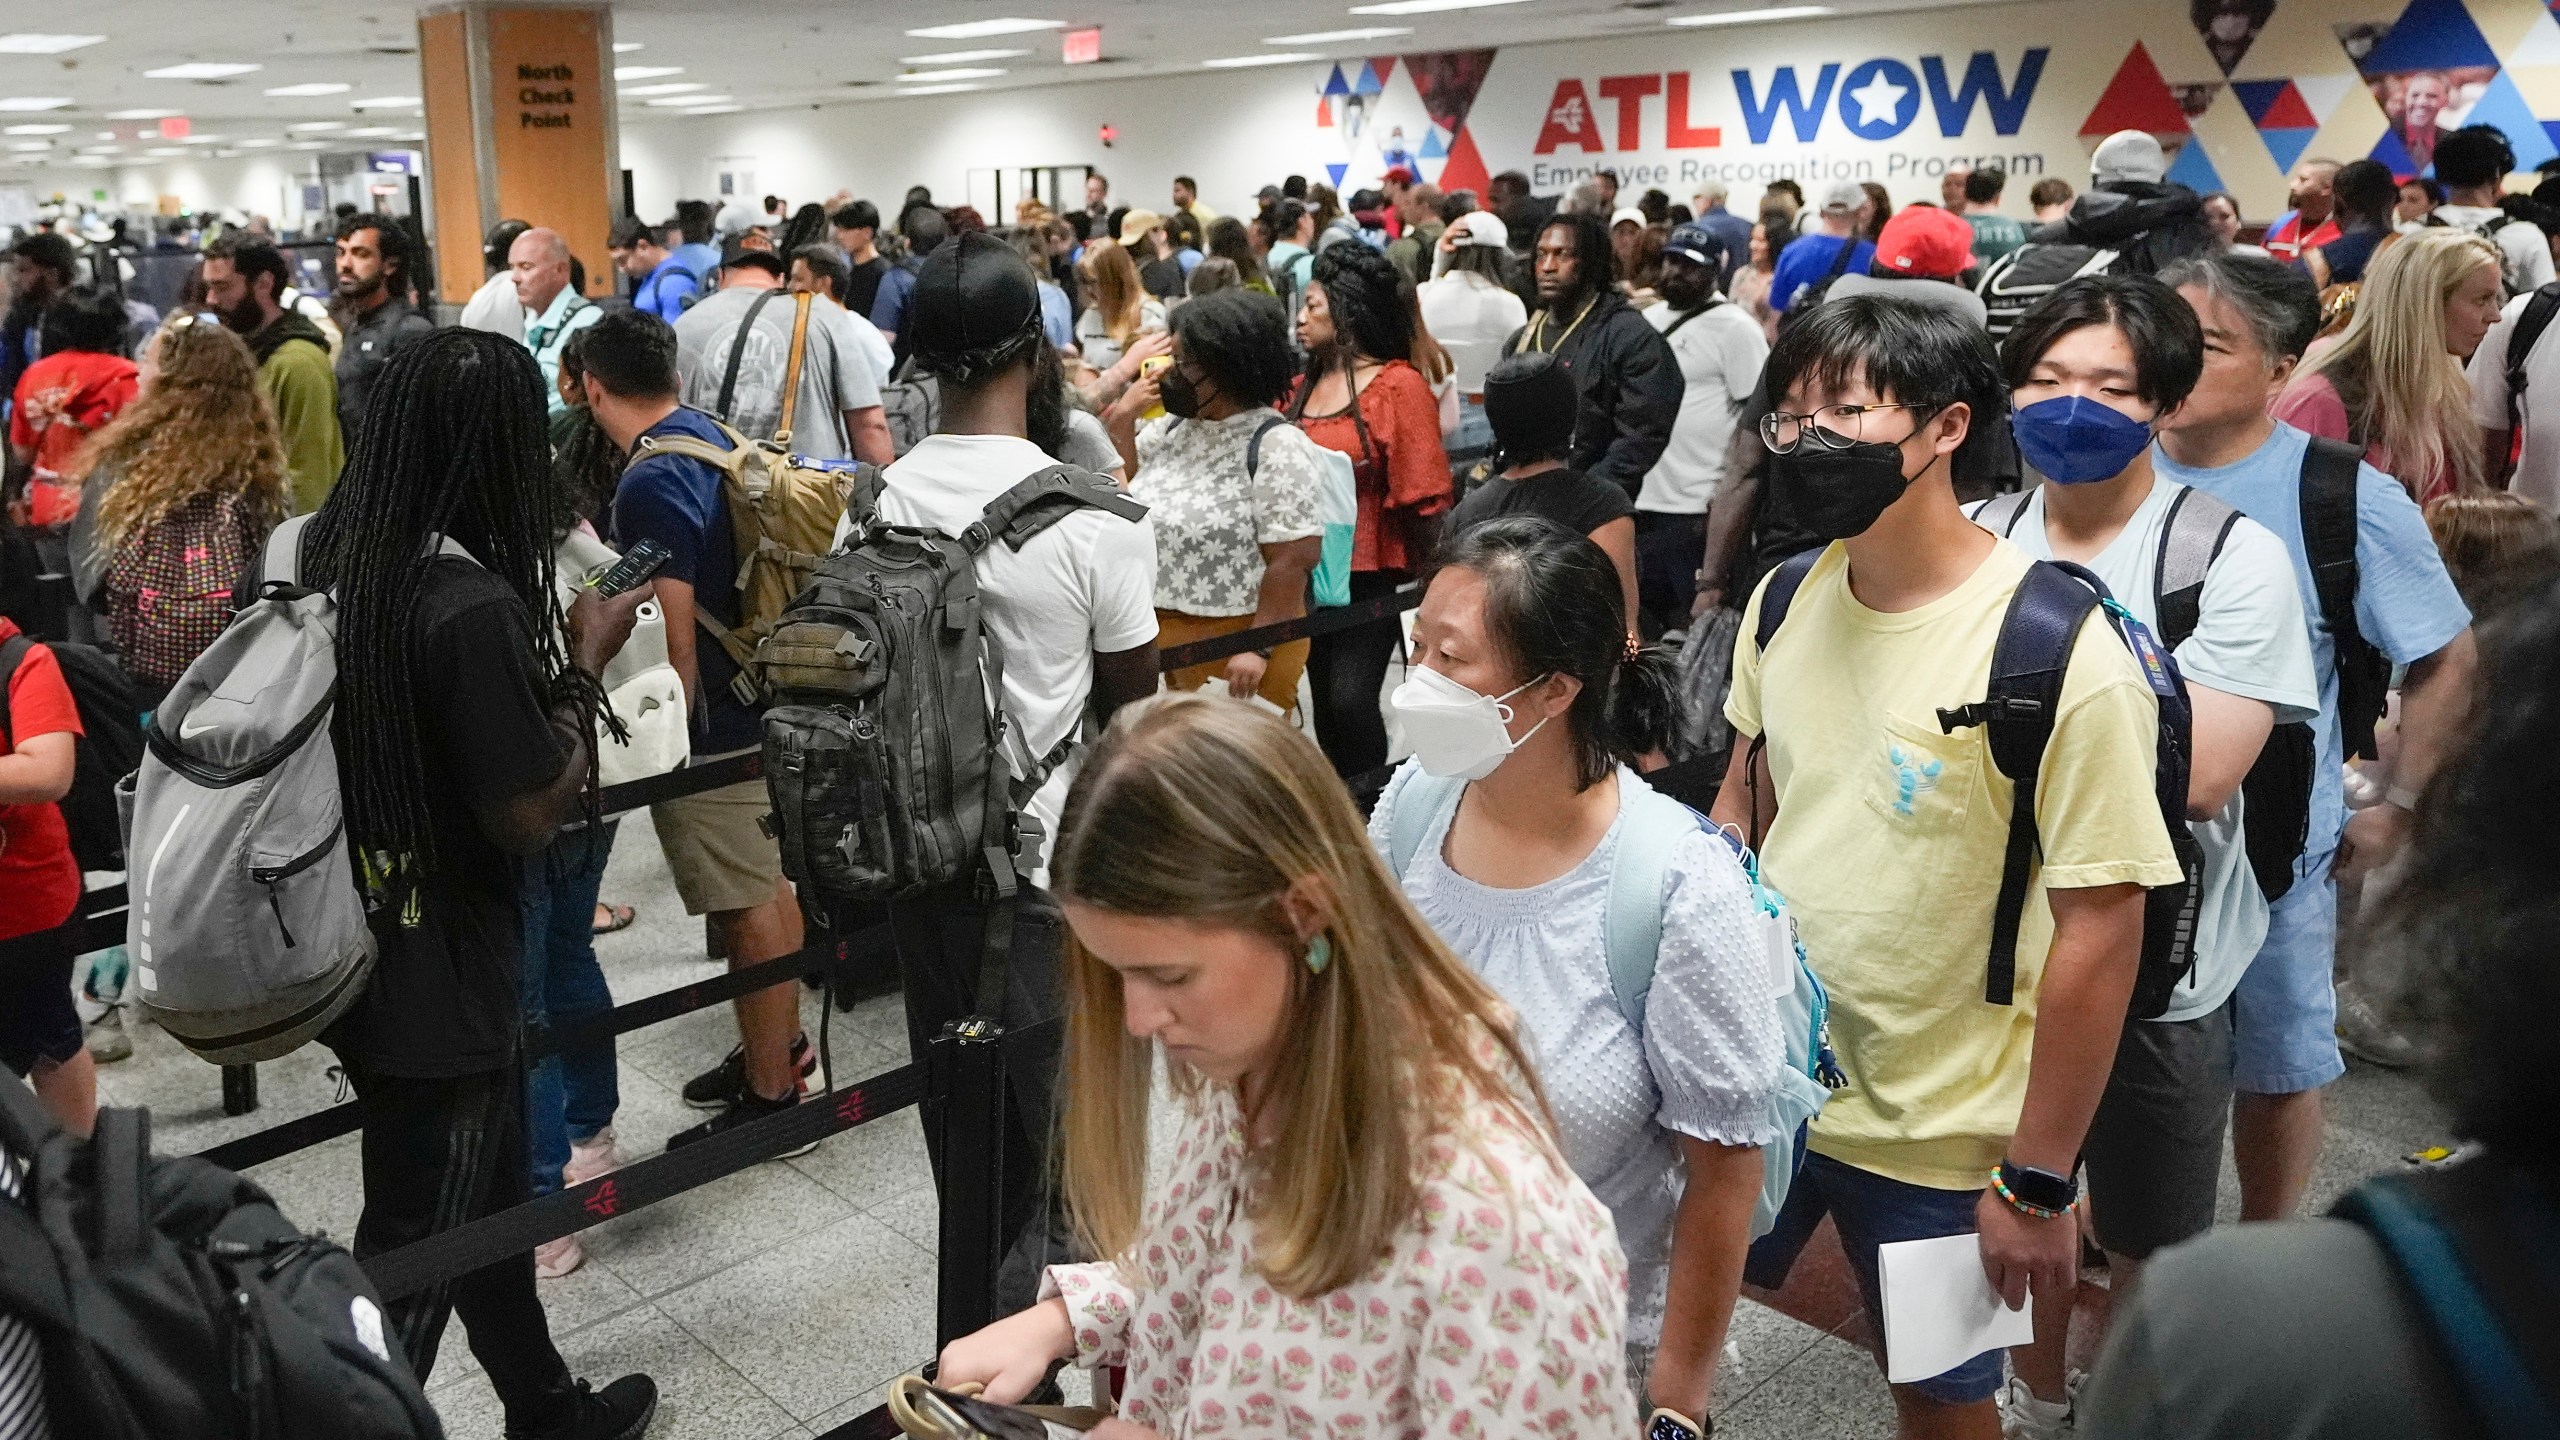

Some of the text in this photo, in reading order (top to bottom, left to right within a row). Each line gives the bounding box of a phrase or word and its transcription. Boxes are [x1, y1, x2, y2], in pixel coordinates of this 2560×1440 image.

[518, 64, 573, 81] North
[519, 88, 573, 104] Check
[1532, 46, 2050, 155] ATL WOW
[521, 111, 571, 129] Point
[1681, 154, 1872, 186] Recognition
